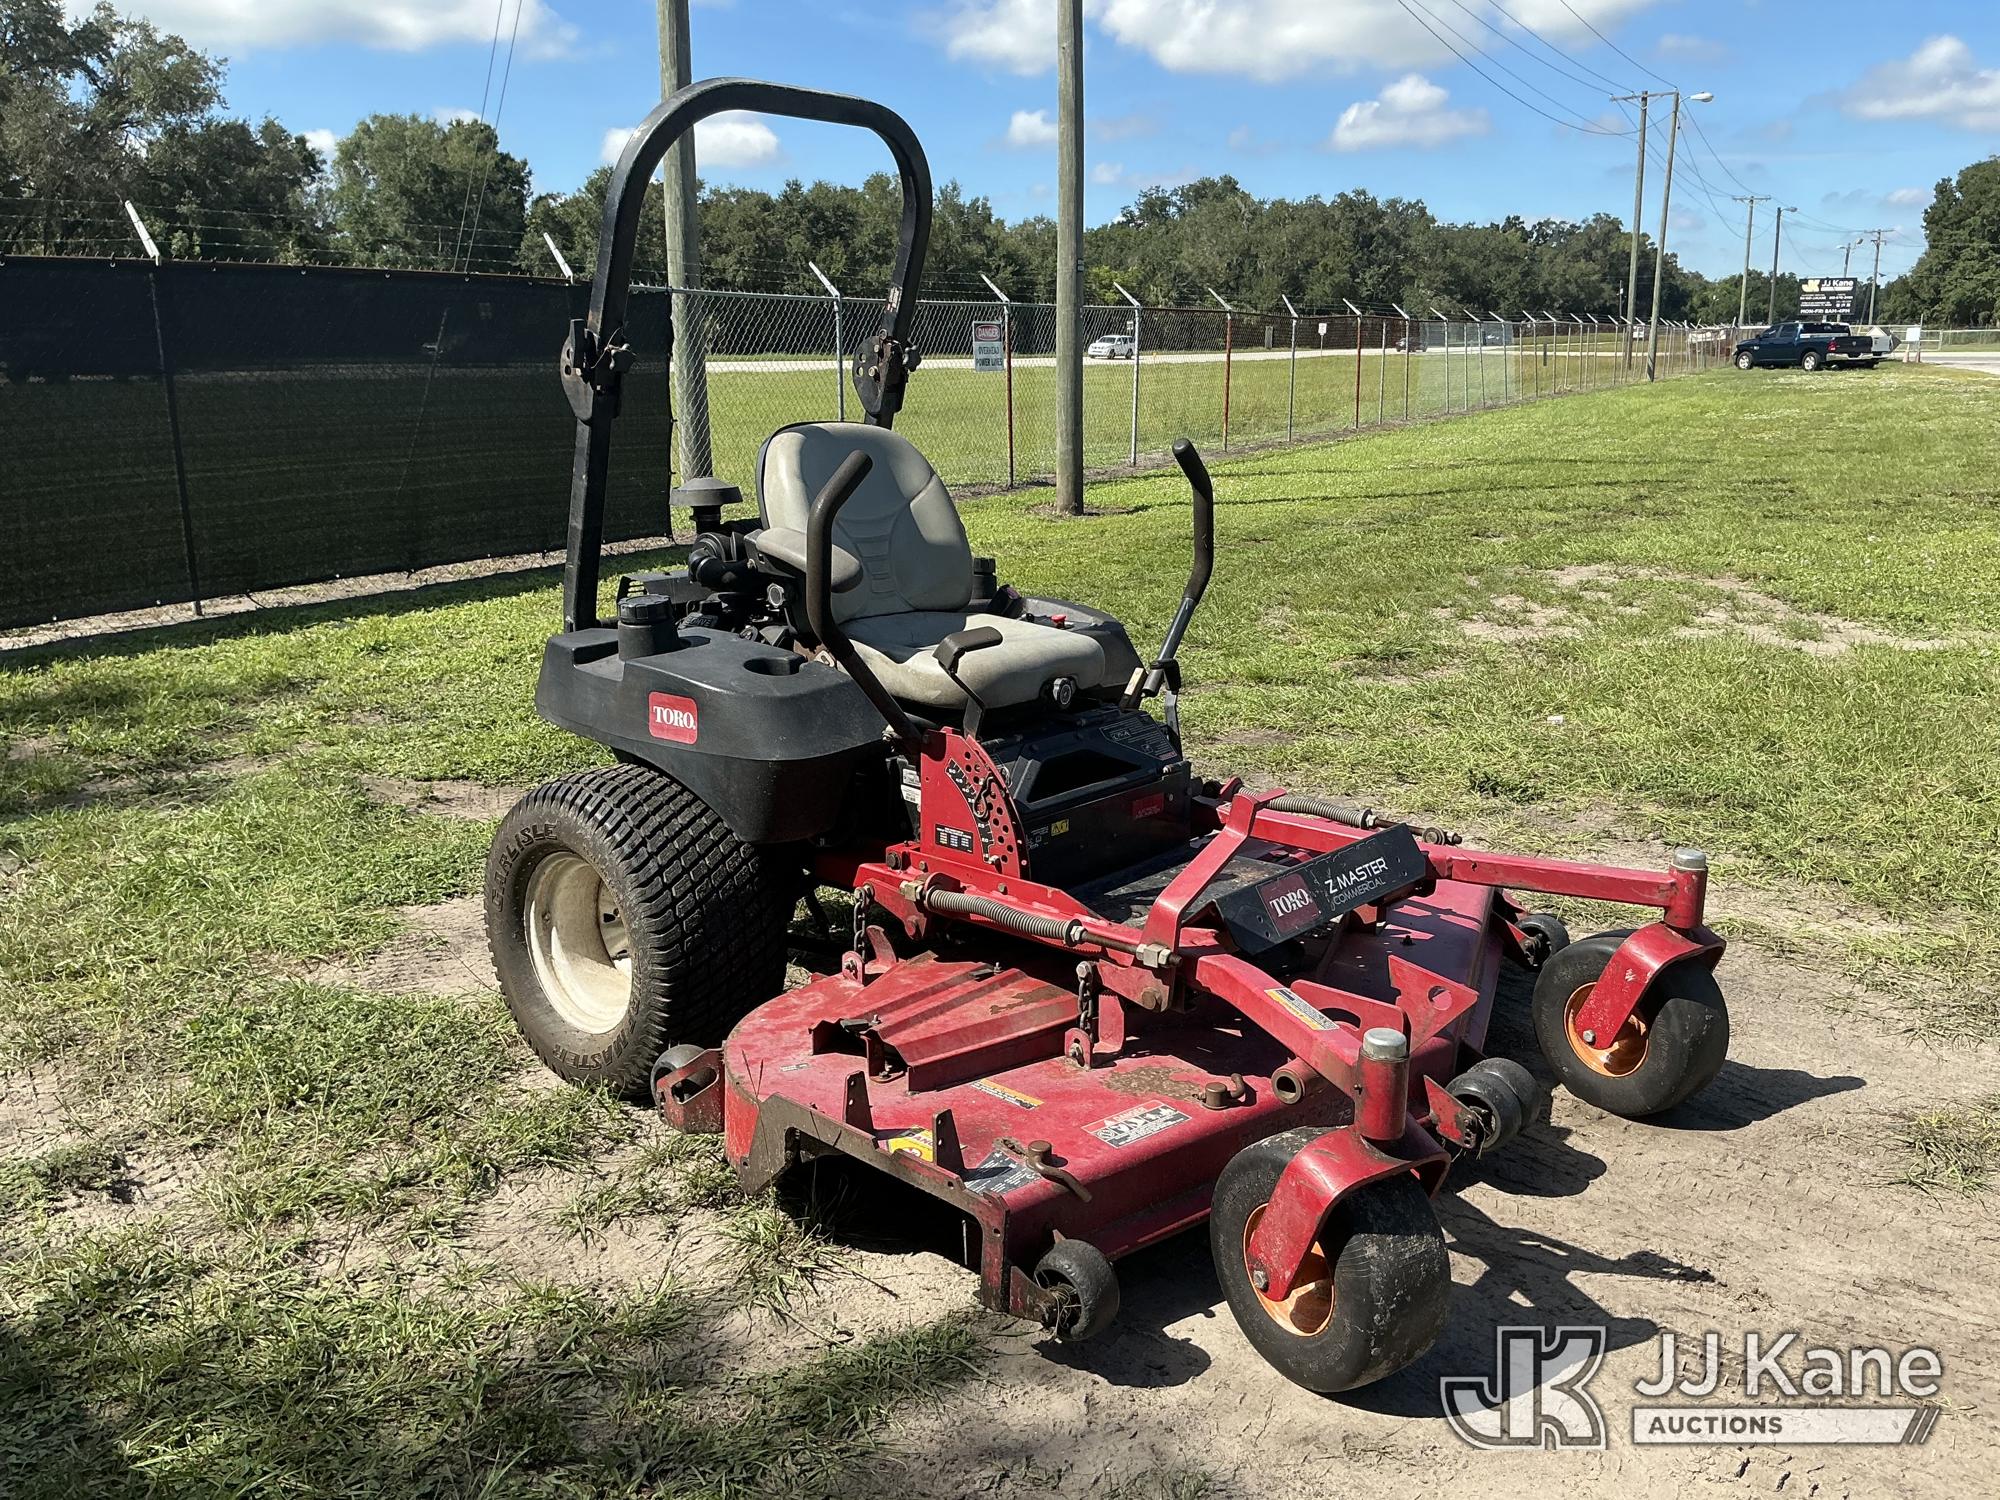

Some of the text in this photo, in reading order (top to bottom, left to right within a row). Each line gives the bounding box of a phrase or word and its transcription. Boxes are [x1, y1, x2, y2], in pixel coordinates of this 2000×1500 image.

[978, 327, 999, 337] DANGER
[491, 822, 558, 912] CARLISLE
[1324, 856, 1388, 894] Z MASTER
[1332, 877, 1387, 906] COMMERCIAL
[1112, 1106, 1147, 1121] DANGER
